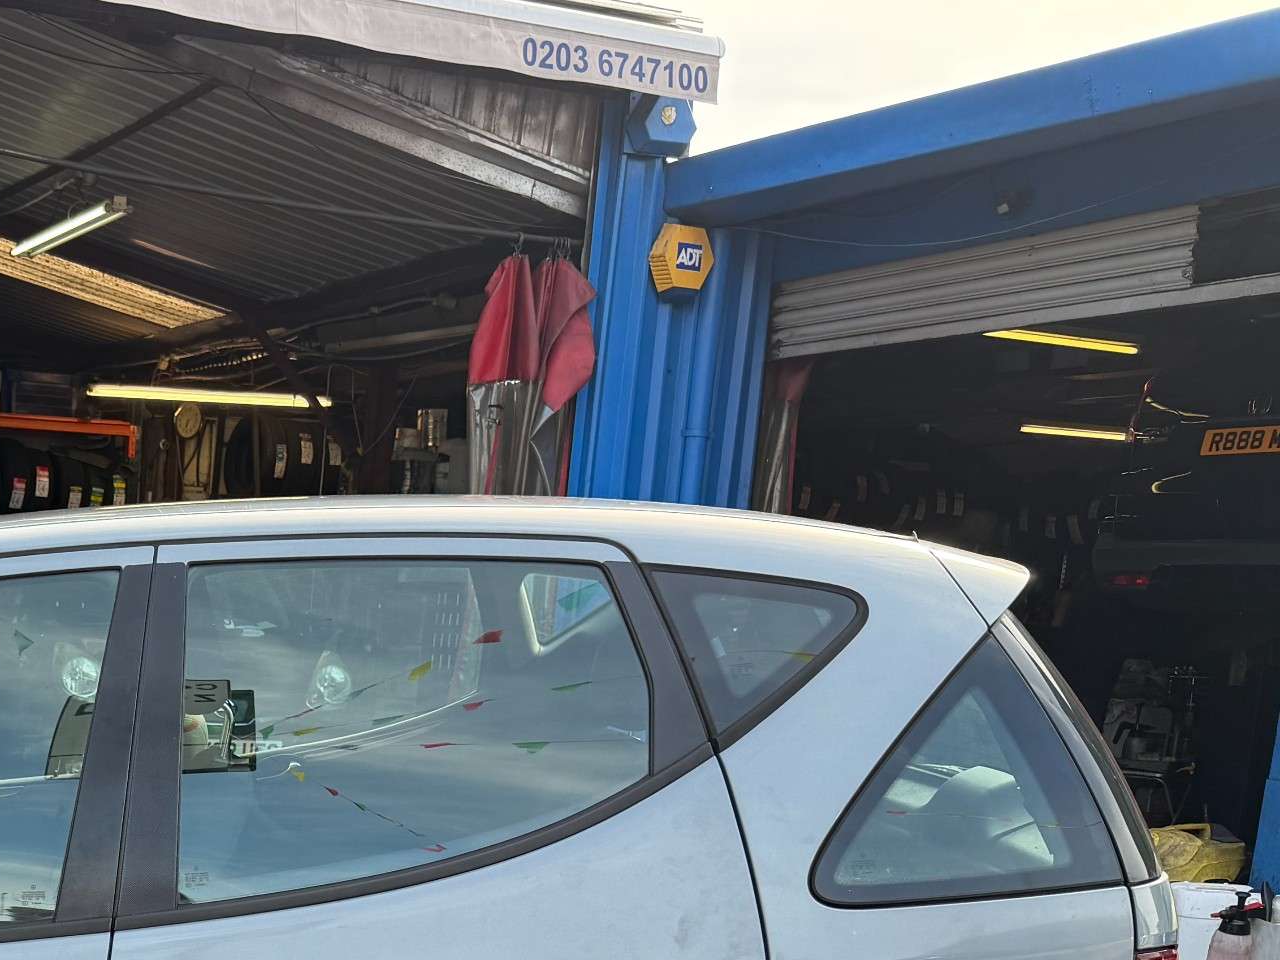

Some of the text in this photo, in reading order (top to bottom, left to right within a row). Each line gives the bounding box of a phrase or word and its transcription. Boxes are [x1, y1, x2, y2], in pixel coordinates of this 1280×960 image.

[522, 37, 709, 93] 0203 6747100
[676, 247, 703, 267] ADT
[1208, 430, 1266, 452] R888
